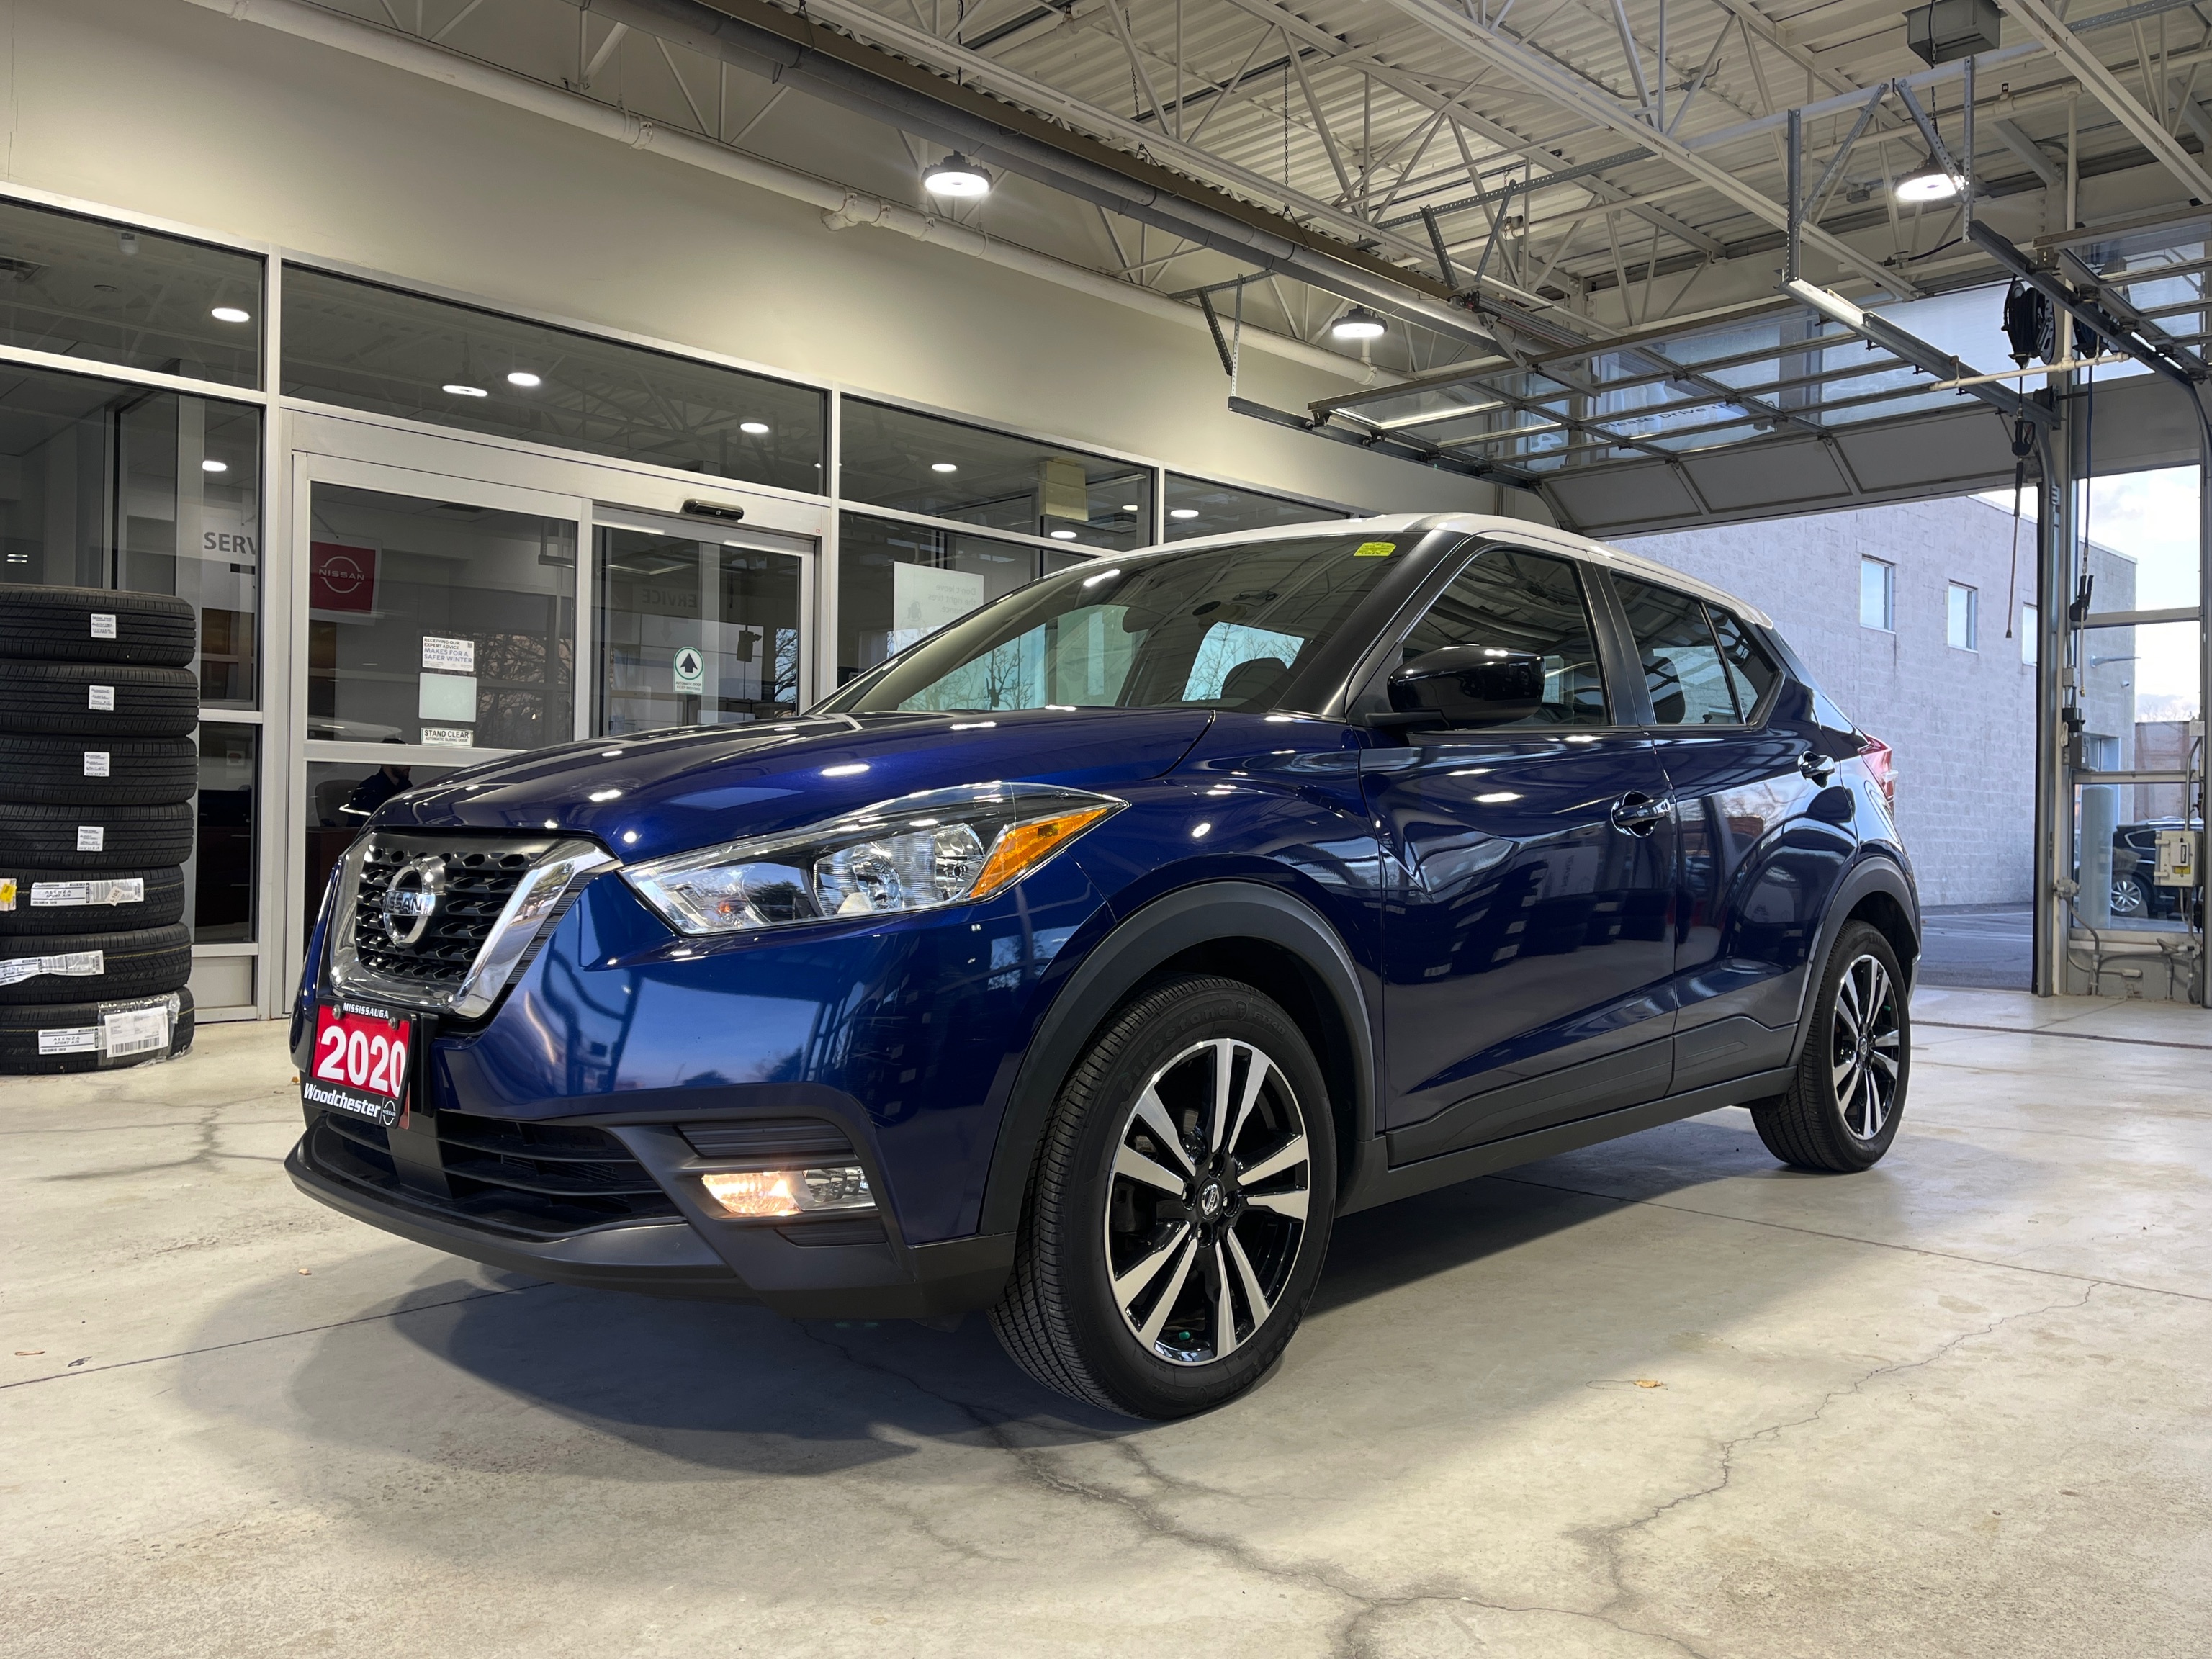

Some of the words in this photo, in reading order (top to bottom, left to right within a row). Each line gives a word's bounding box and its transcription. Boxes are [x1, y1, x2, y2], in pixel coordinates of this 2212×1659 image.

[318, 568, 365, 581] NISSAN
[343, 1002, 389, 1019] MISSISSAUGA
[317, 1025, 406, 1098] 2020
[1120, 1004, 1230, 1094] Firestone
[303, 1082, 382, 1118] Woodchester
